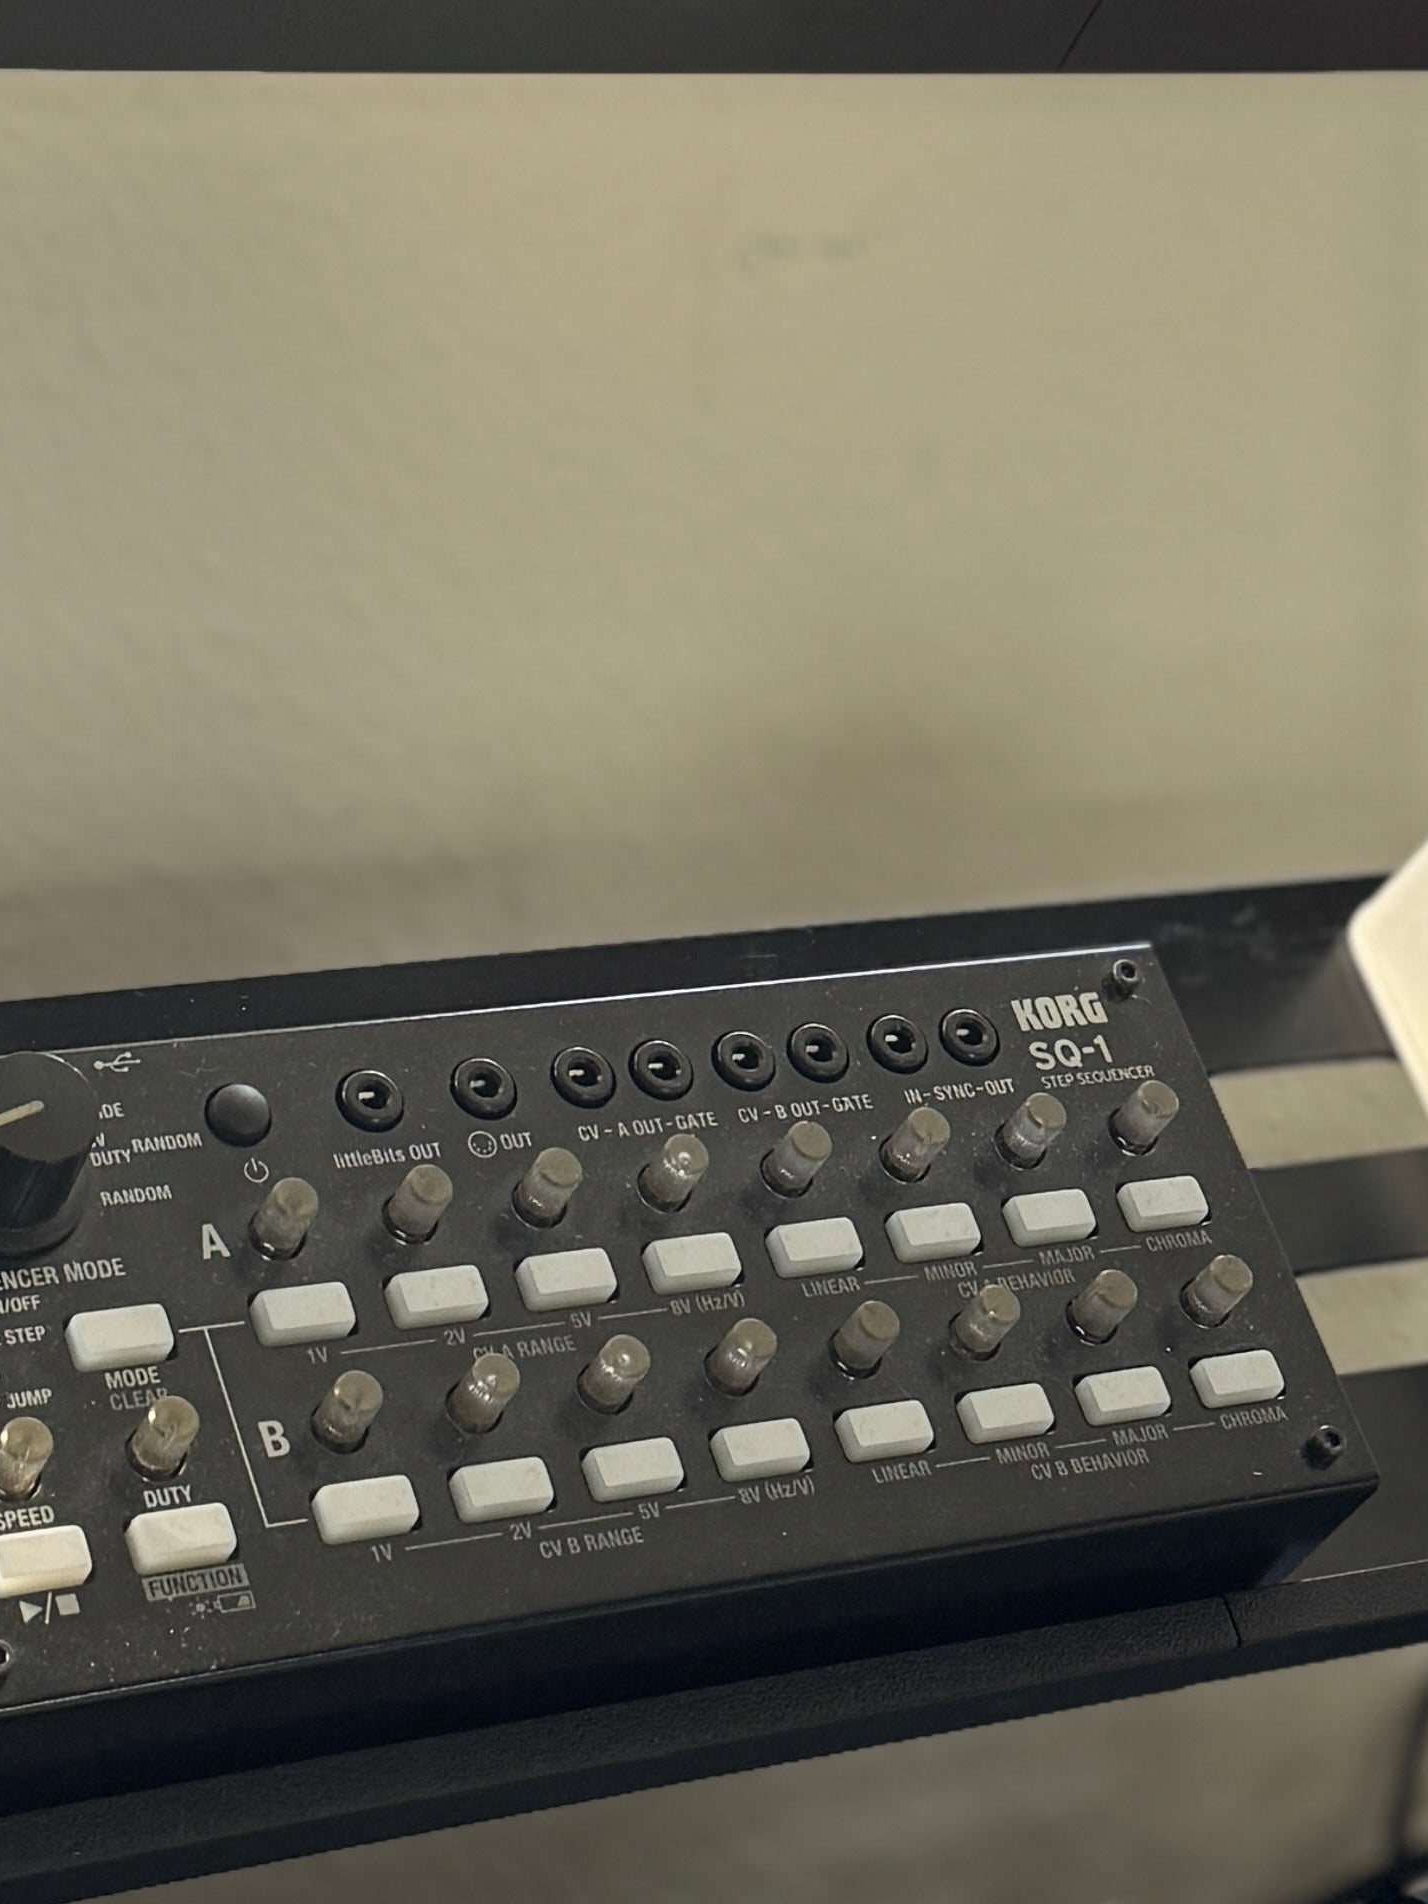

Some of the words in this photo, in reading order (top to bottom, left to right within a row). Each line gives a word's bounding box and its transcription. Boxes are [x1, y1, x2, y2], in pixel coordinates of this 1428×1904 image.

[1010, 992, 1109, 1033] KORG
[1028, 1036, 1115, 1071] SQ-1
[1041, 1073, 1074, 1090] STEP
[1075, 1064, 1155, 1087] SEQUENCER
[738, 1102, 762, 1124] CV
[132, 1132, 203, 1153] RANDOM
[500, 1132, 532, 1151] OUT
[578, 1124, 599, 1141] CV
[90, 1149, 130, 1167] DUTY
[333, 1146, 405, 1169] littleBits
[409, 1142, 442, 1161] OUT
[100, 1185, 172, 1206] RANDOM
[201, 1224, 230, 1259] A
[62, 1258, 126, 1282] MODE
[801, 1276, 861, 1299] LINEAR
[924, 1262, 978, 1283] MINOR
[1039, 1244, 1096, 1267] MAJOR
[1145, 1230, 1213, 1252] CHROMA
[957, 1279, 978, 1296] CV
[5, 1326, 46, 1346] STEP
[307, 1347, 329, 1364] 1V
[444, 1330, 465, 1346] 2V
[571, 1312, 592, 1329] 5V
[696, 1291, 746, 1315] (Hz/V)
[518, 1334, 577, 1357] RANGE
[104, 1367, 161, 1390] MODE
[7, 1389, 52, 1409] JUMP
[258, 1420, 290, 1457] B
[871, 1460, 932, 1484] LINEAR
[995, 1442, 1051, 1466] MINOR
[1111, 1423, 1169, 1446] MAJOR
[1220, 1406, 1289, 1430] CHROMA
[1031, 1462, 1053, 1480] CV
[1057, 1459, 1069, 1477] B
[1072, 1448, 1150, 1475] BEHAVIOR
[143, 1485, 193, 1507] DUTY
[371, 1544, 392, 1562] 1V
[510, 1523, 532, 1540] 2V
[638, 1503, 660, 1520] 5V
[766, 1476, 815, 1501] (Hz/V)
[540, 1540, 565, 1559] CV
[569, 1537, 580, 1554] B
[583, 1527, 643, 1553] RANGE
[148, 1566, 242, 1598] FUNCTION
